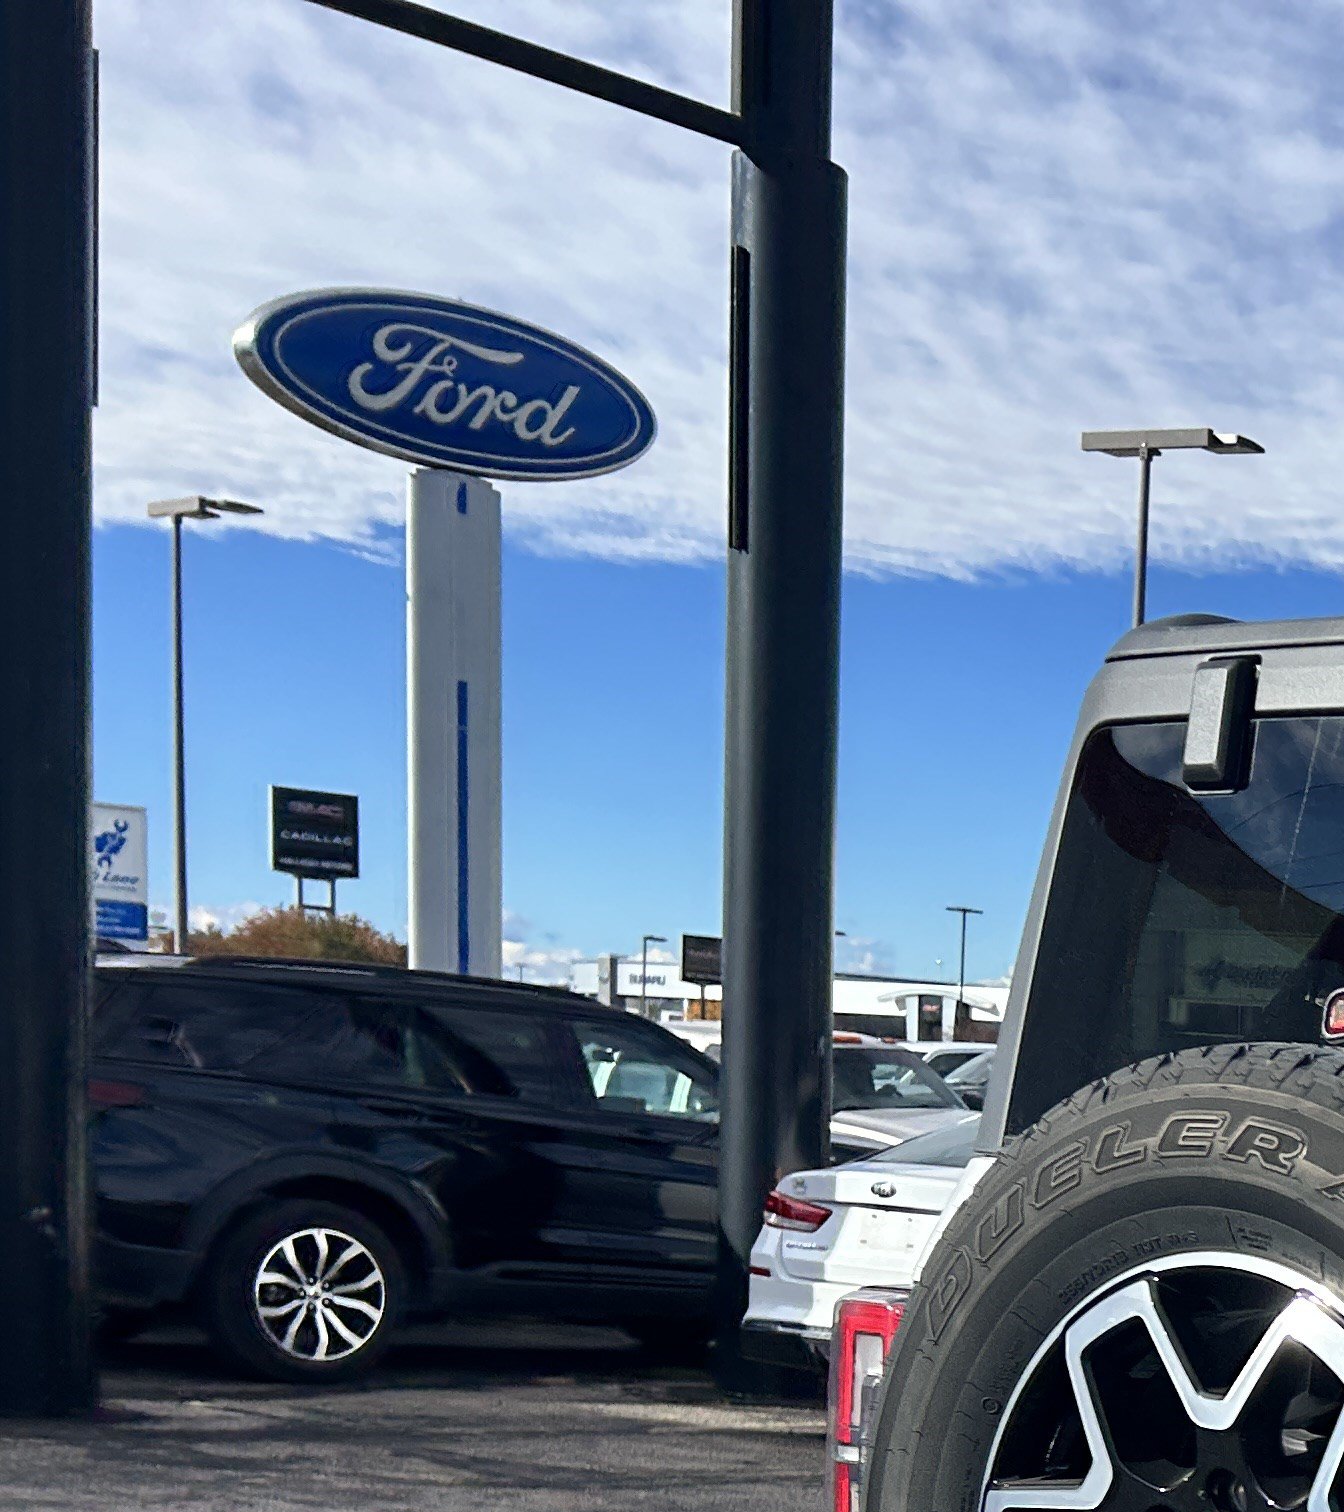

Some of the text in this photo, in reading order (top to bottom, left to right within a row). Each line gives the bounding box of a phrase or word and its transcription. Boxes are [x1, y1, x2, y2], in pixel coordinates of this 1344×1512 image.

[348, 322, 581, 446] Ford
[280, 829, 354, 847] CADILLAC
[922, 1108, 1311, 1345] DUELER
